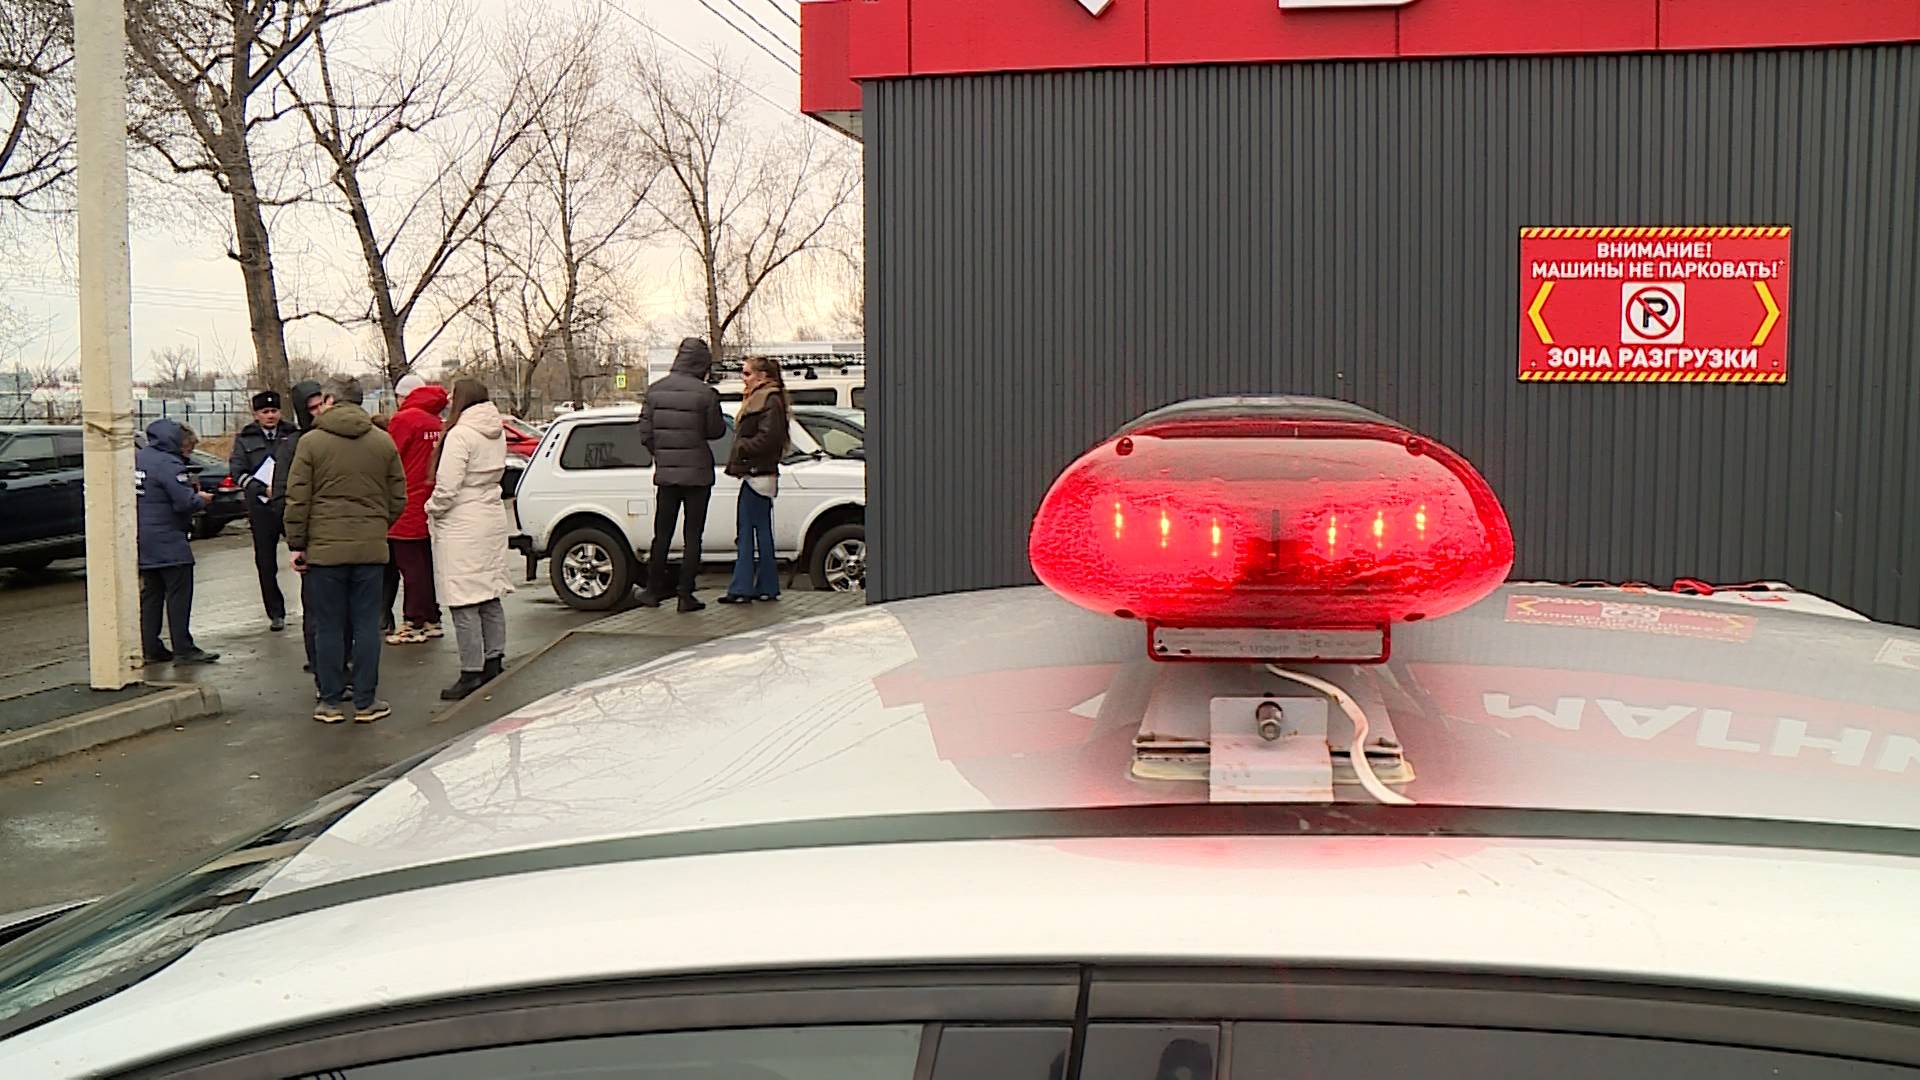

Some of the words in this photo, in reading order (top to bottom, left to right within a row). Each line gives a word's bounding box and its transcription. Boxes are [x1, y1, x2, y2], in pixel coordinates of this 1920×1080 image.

[1596, 241, 1712, 259] ВНИМАНИЕ!
[1531, 261, 1624, 279] МАШИНЫ
[1628, 261, 1654, 278] НЕ
[1657, 261, 1777, 279] ПАРКОВАТЬ!
[1547, 347, 1613, 368] ЗОНА
[1617, 347, 1758, 369] РАЗГРУЗКИ
